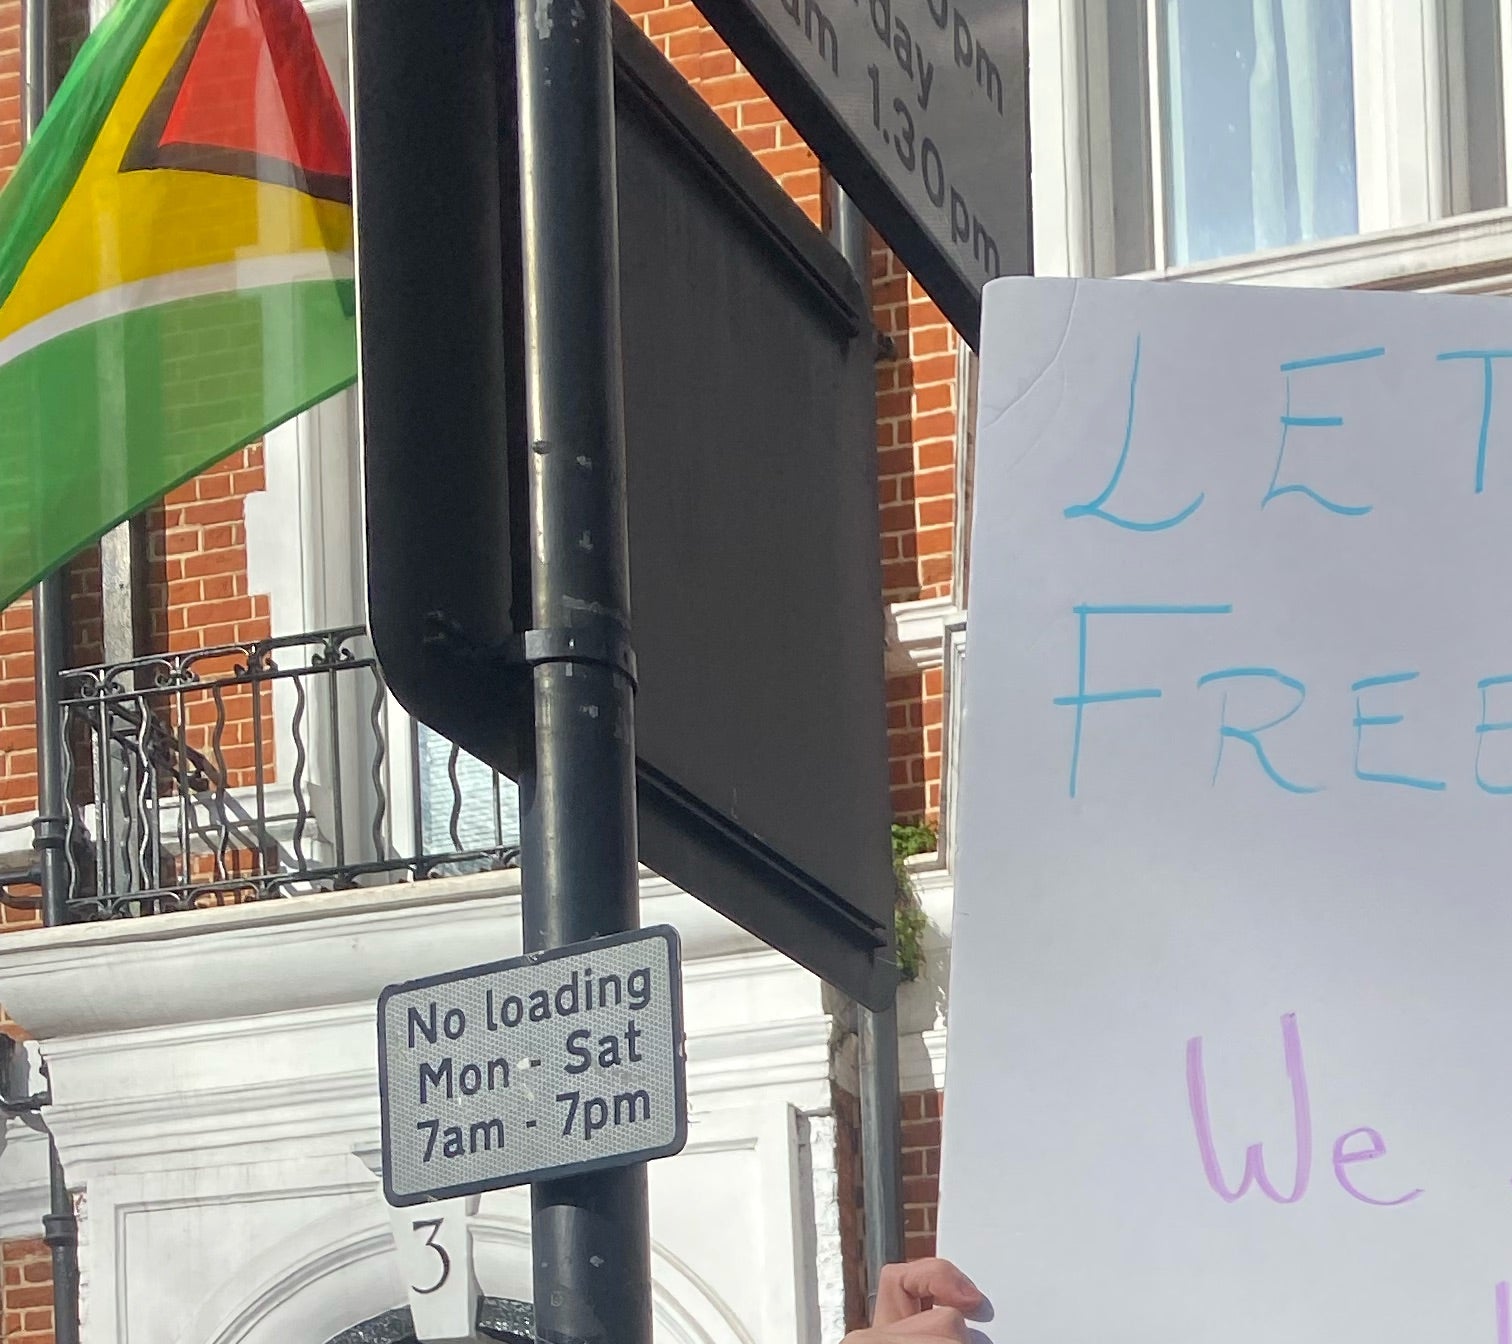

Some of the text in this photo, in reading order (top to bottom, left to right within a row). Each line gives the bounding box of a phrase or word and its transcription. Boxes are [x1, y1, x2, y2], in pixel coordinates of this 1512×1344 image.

[406, 967, 652, 1049] No loading
[418, 1055, 510, 1105] Mon
[564, 1019, 643, 1075] Sat
[416, 1115, 505, 1163] 7am
[556, 1087, 652, 1141] 7pm
[1185, 1011, 1425, 1206] We
[411, 1217, 451, 1295] 3
